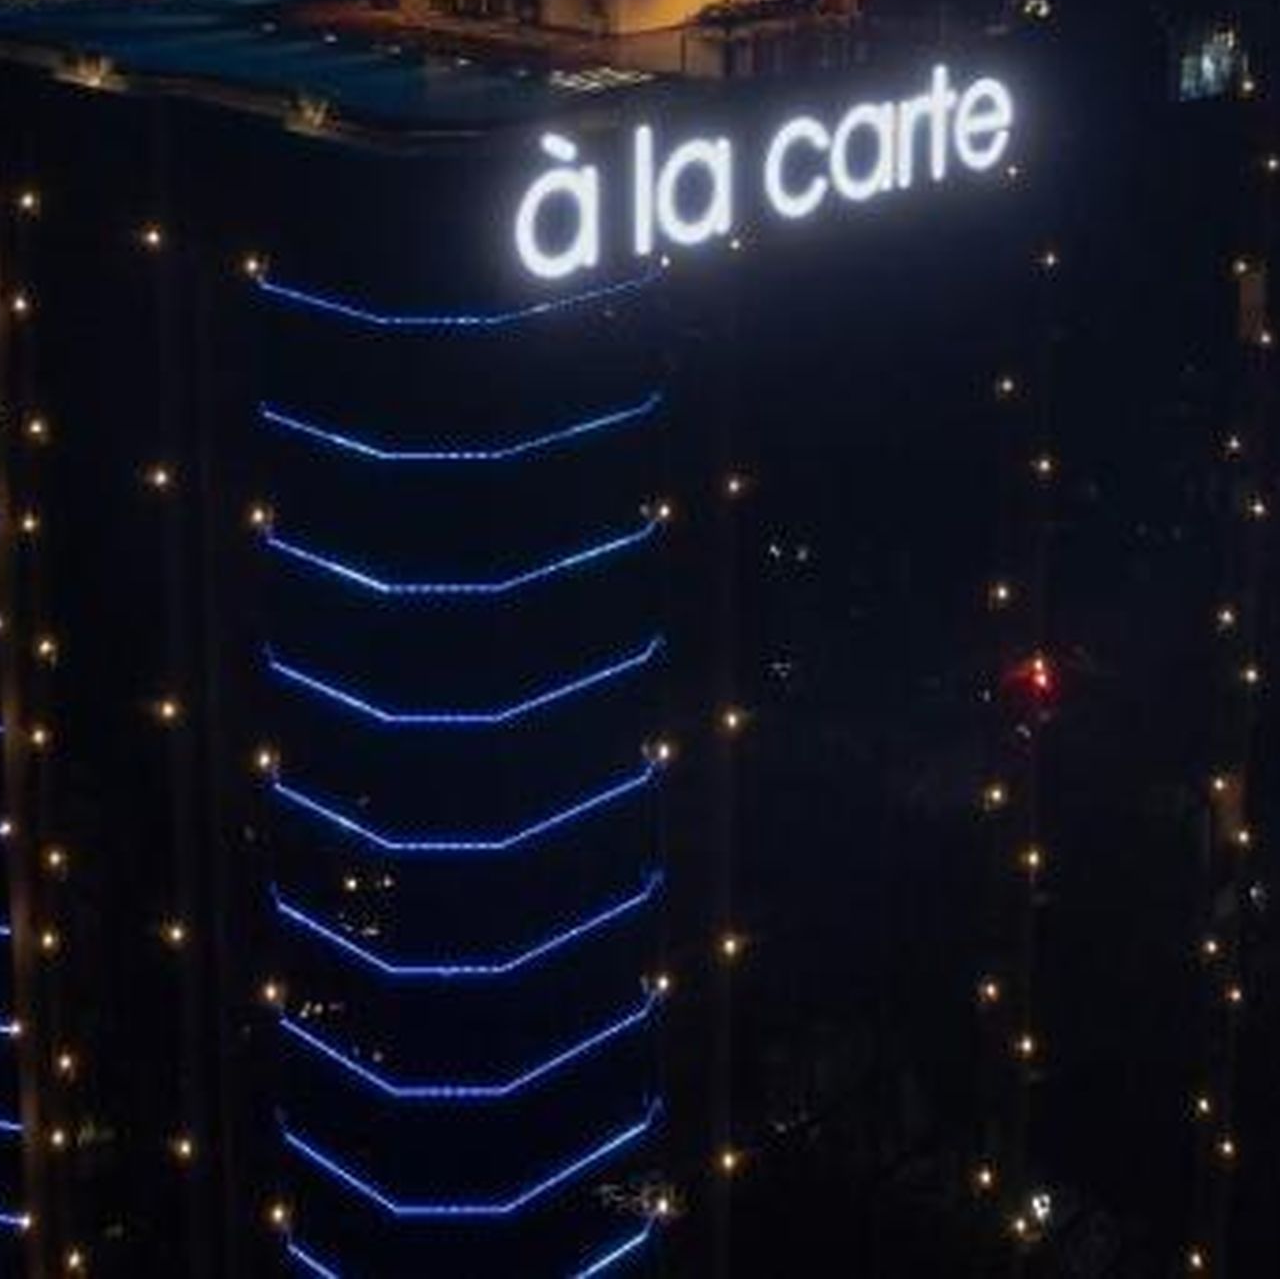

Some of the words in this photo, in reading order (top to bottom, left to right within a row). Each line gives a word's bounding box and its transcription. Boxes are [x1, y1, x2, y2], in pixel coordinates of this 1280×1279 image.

[515, 132, 598, 279] à
[634, 124, 732, 255] la
[764, 63, 1014, 217] carte
